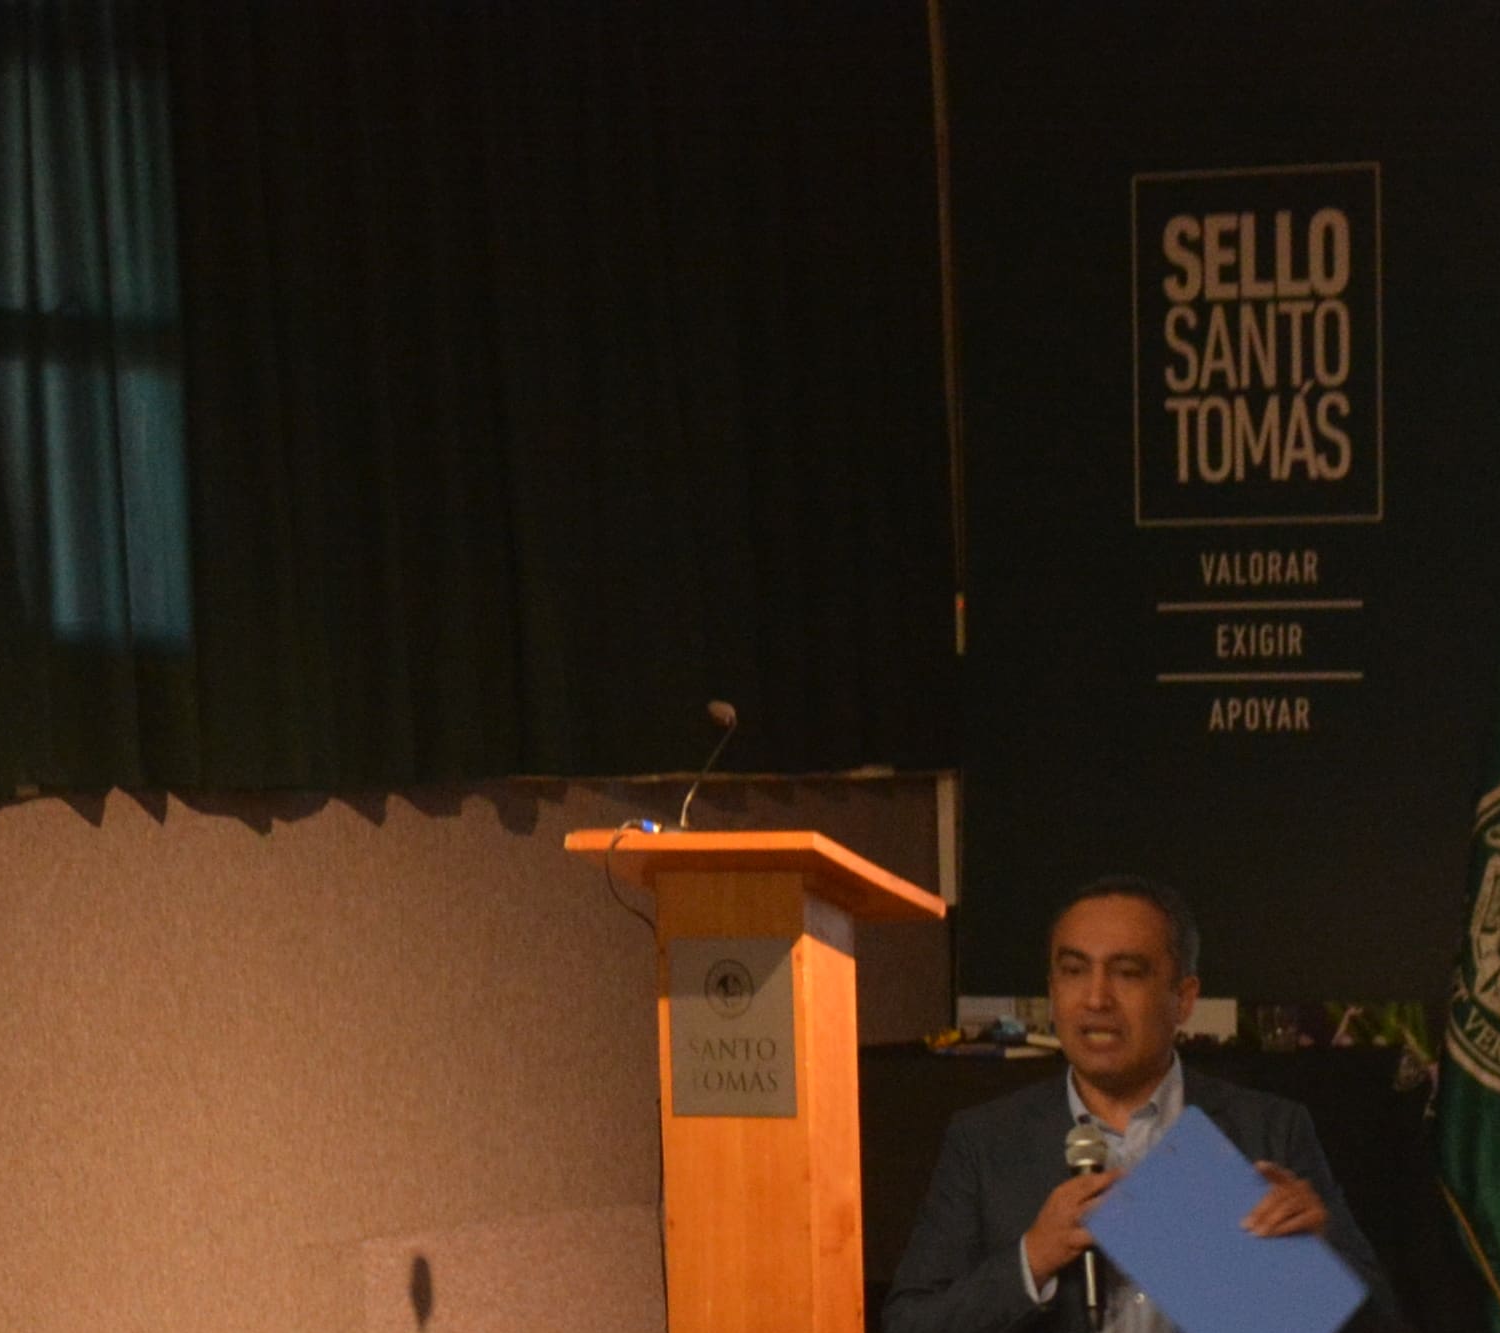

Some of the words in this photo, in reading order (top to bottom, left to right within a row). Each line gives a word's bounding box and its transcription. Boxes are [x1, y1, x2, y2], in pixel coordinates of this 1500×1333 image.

[1162, 207, 1352, 303] SELLO
[1163, 300, 1351, 393] SANTO
[1164, 379, 1353, 484] TOMÁS
[1200, 550, 1320, 587] VALORAR
[1216, 624, 1304, 658] EXIGIR
[1209, 698, 1312, 732] APOYAR
[690, 1036, 777, 1062] SANTO
